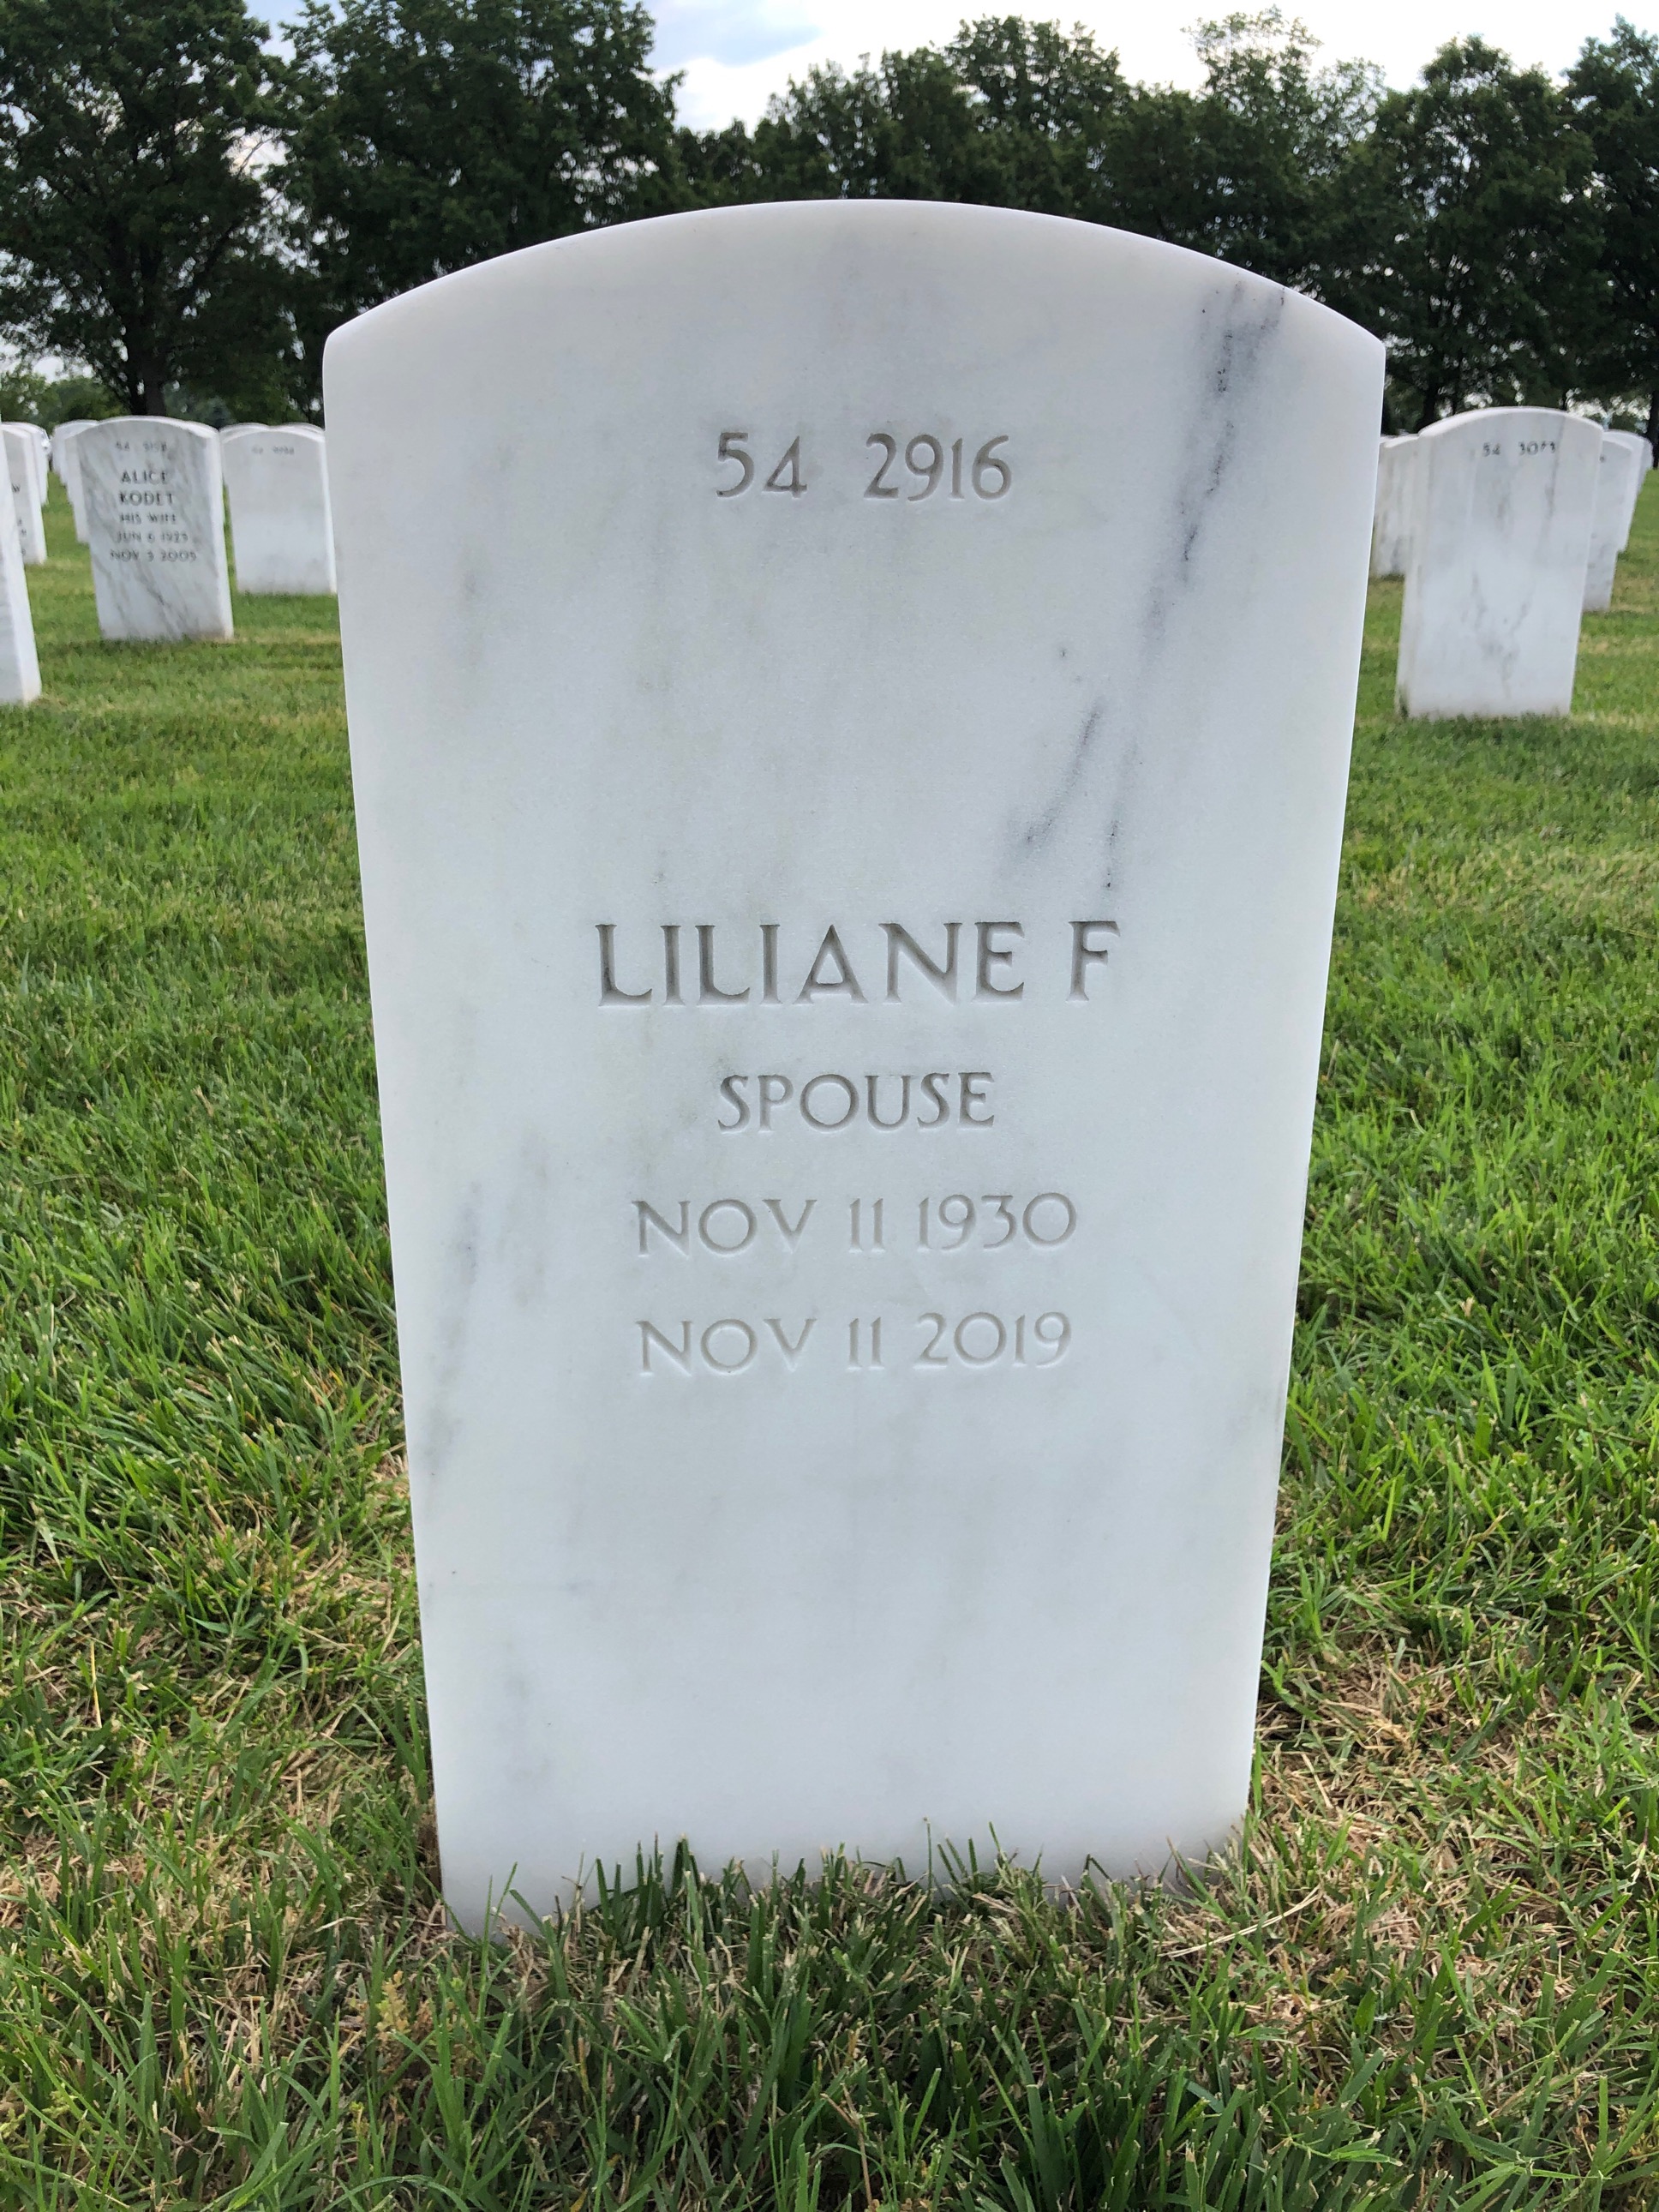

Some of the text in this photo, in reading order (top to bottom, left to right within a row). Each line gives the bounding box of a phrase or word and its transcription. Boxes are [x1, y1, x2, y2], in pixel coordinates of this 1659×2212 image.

[121, 470, 170, 484] ALICE
[716, 431, 1012, 501] 54 2916
[119, 491, 174, 506] KODET
[110, 549, 140, 562] NOV
[595, 920, 1121, 1007] LILIANE F
[717, 1071, 996, 1133] SPOUSE
[631, 1192, 1077, 1256] NOV 11 1930
[636, 1310, 1072, 1376] NOV 11 2019
